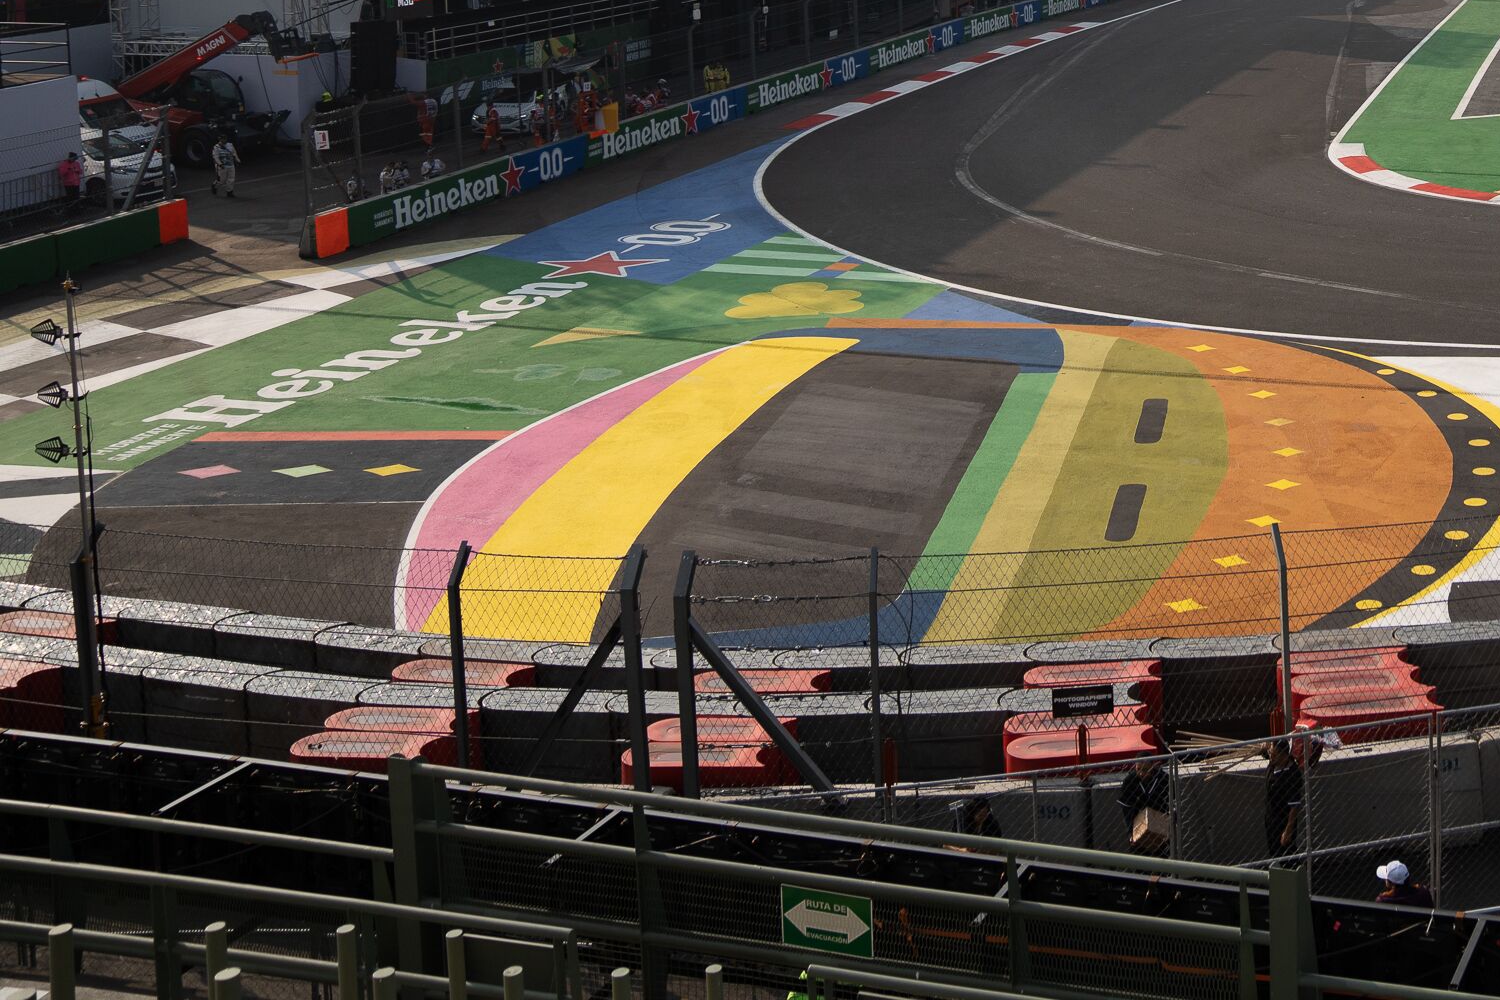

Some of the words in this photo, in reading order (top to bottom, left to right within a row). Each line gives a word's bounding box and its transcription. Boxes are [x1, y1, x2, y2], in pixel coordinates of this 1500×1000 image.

[970, 12, 1010, 38] Heineken
[196, 34, 227, 58] MAGNI
[878, 38, 925, 68] Heineken
[758, 71, 820, 107] Heineken
[602, 114, 681, 160] Heineken
[394, 173, 499, 229] Heineken
[142, 276, 588, 428] Heineken
[617, 219, 732, 246] 0.0
[92, 423, 180, 456] HIDRATATE
[108, 424, 207, 462] SANAMENTE
[807, 899, 830, 911] RUTA
[834, 903, 847, 913] DE
[806, 932, 848, 944] EVACUACIÓN
